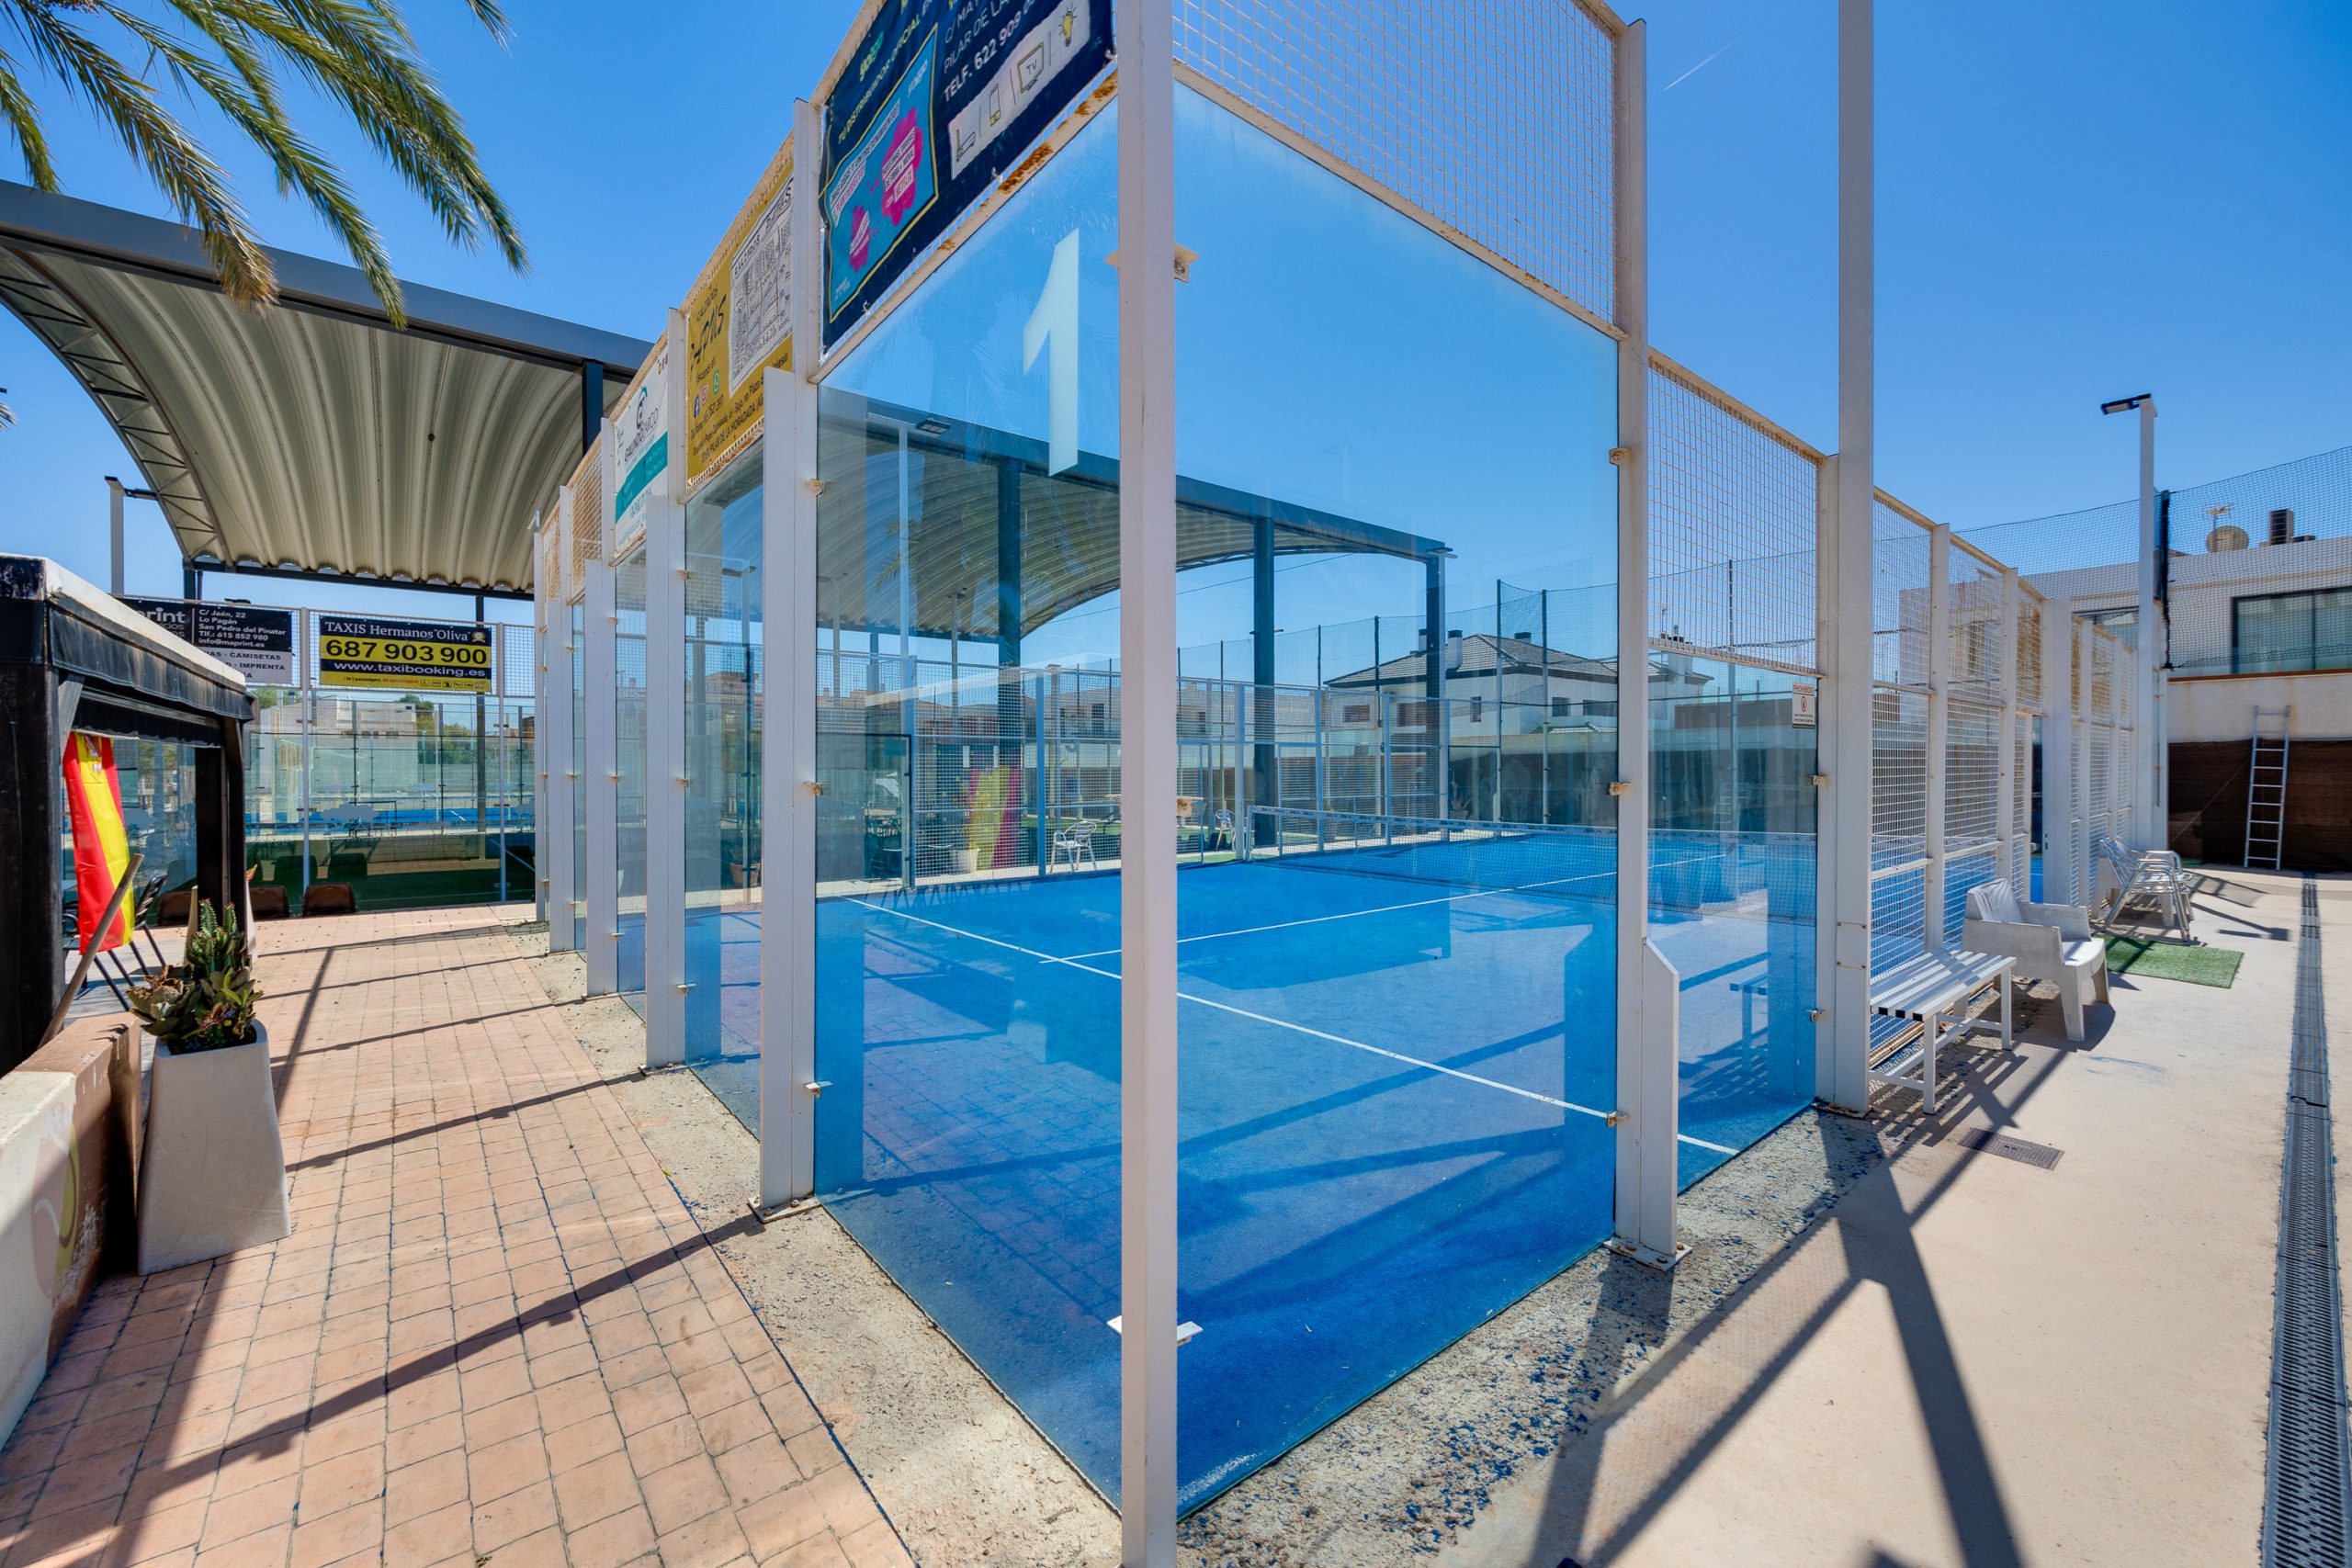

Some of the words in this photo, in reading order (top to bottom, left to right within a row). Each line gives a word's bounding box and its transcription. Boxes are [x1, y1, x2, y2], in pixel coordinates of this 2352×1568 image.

[944, 29, 973, 74] PILAR
[974, 7, 989, 38] DE
[944, 63, 973, 103] TELF.
[974, 38, 998, 71] 622
[999, 10, 1022, 47] 909
[1023, 227, 1080, 478] 1
[211, 616, 237, 626] Pagán
[234, 632, 251, 640] 852
[324, 621, 368, 635] TAXIS
[369, 625, 434, 639] Hermanos
[198, 637, 266, 648] info@maprint.es
[229, 651, 281, 660] CAMISETAS
[325, 639, 378, 659] 687
[384, 643, 435, 661] 903
[440, 647, 487, 665] 900
[239, 662, 286, 671] IMPRENTA
[334, 662, 486, 678] www.taxibooking.es
